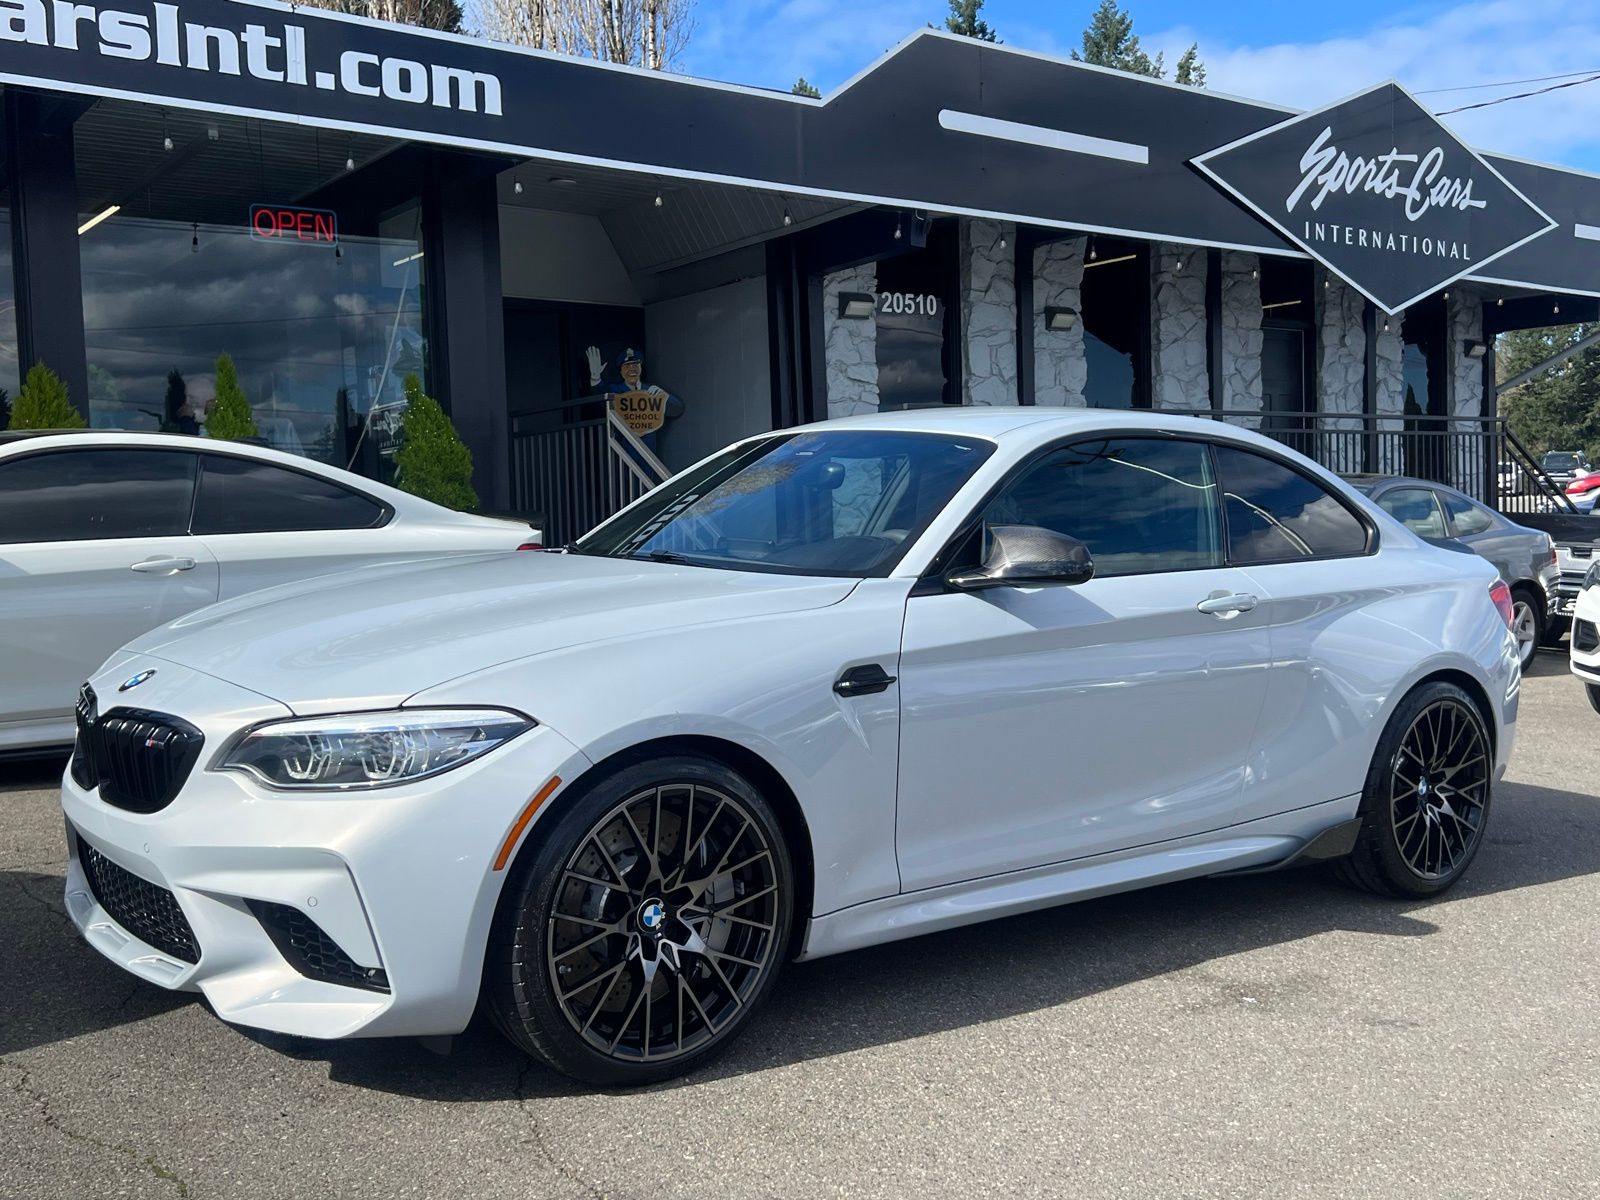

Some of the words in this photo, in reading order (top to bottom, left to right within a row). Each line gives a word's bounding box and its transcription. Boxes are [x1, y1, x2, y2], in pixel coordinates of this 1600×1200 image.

[1285, 126, 1418, 213] Sports
[1405, 146, 1487, 222] Cars
[254, 209, 334, 242] OPEN
[1304, 221, 1471, 261] INTERNATIONAL
[881, 291, 937, 316] 20510
[620, 398, 662, 412] SLOW
[624, 413, 657, 421] SCHOOL
[629, 422, 653, 430] ZONE
